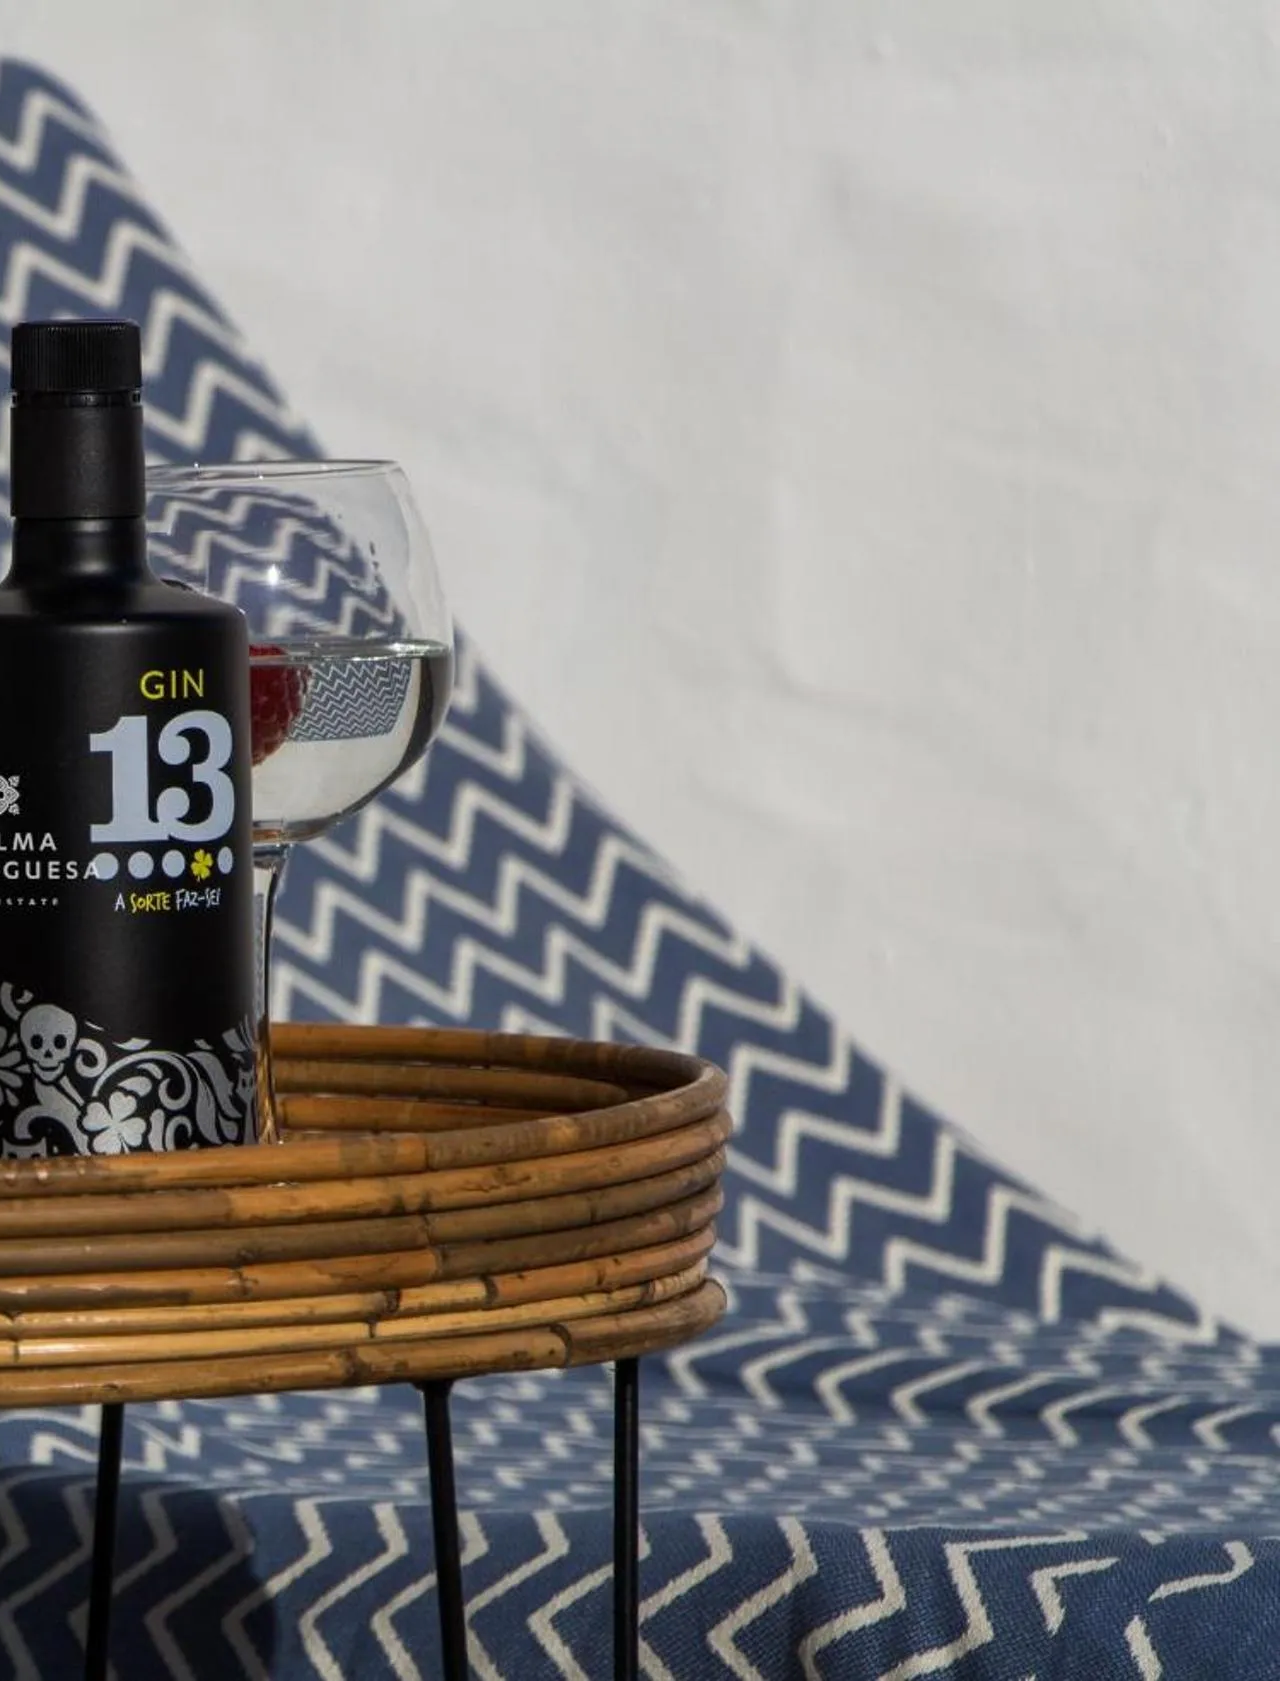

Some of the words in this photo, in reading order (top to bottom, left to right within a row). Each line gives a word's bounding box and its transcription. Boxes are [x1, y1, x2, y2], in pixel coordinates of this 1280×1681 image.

[139, 669, 205, 700] GIN
[89, 709, 235, 843] 13
[114, 893, 126, 912] A
